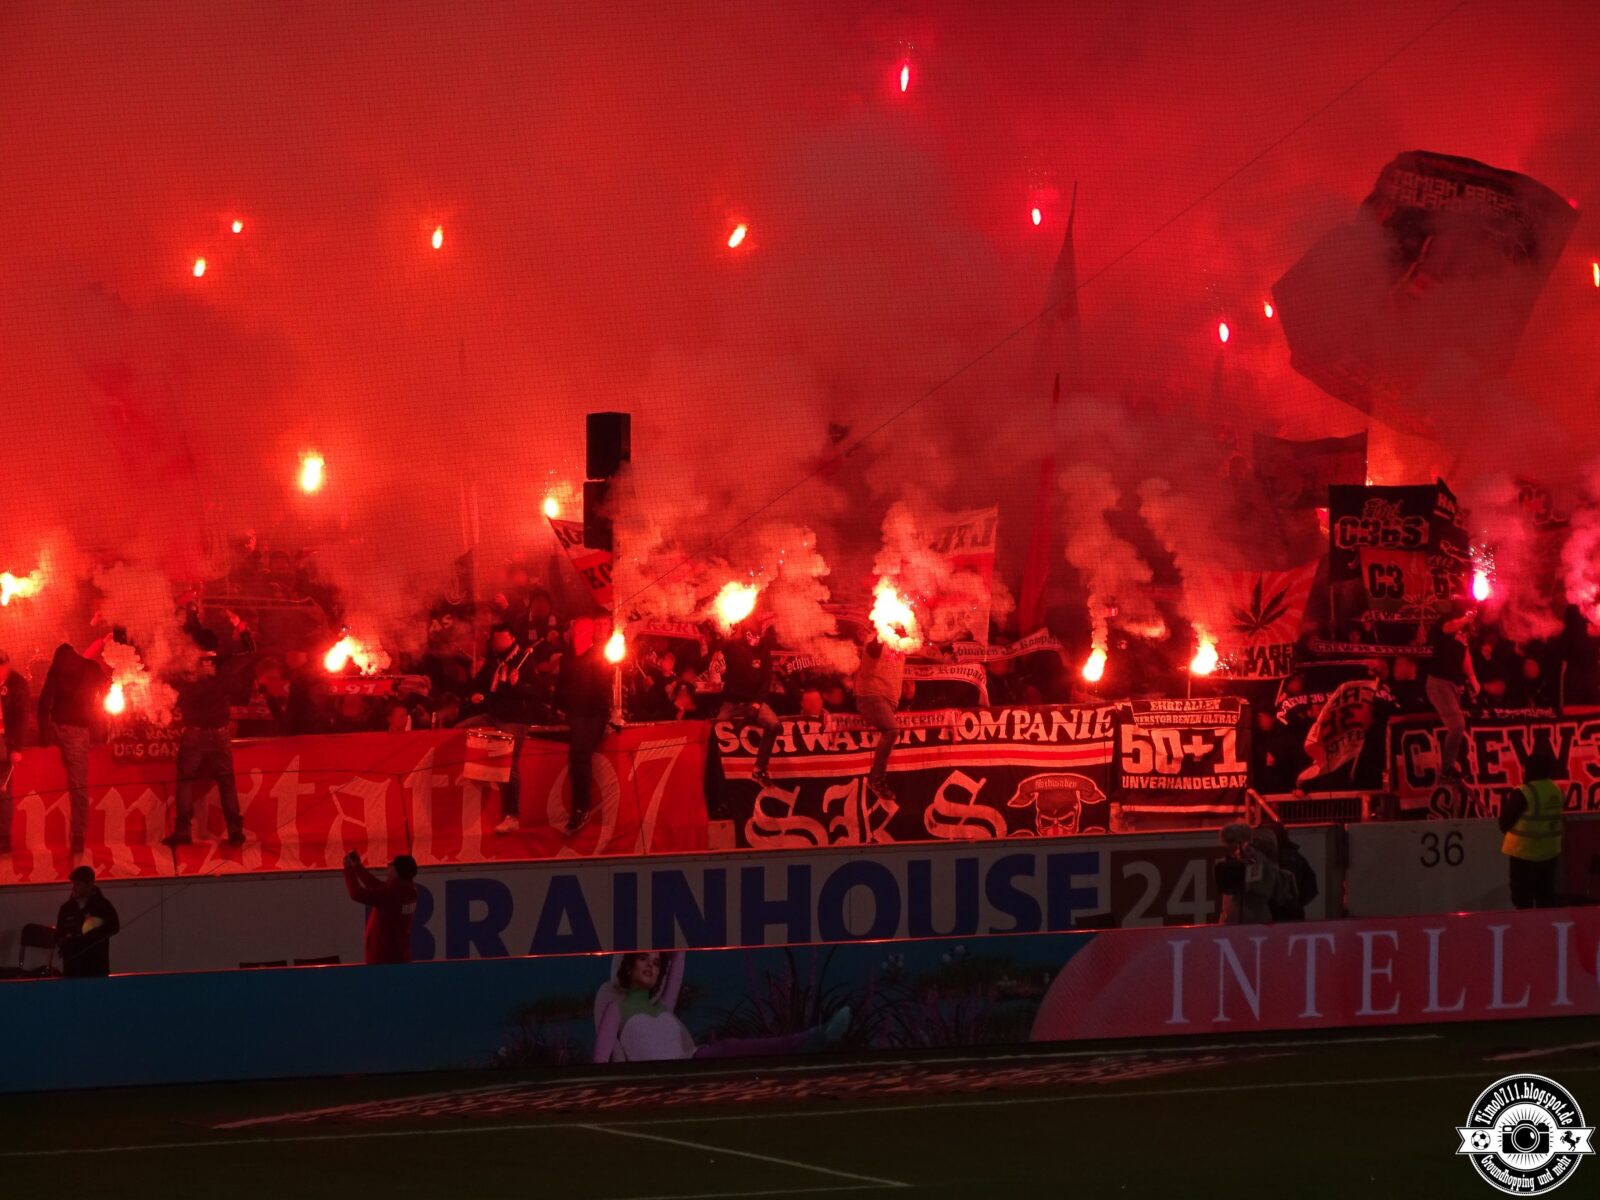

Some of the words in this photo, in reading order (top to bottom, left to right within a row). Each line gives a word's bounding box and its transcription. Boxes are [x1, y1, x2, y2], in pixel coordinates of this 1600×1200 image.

[1150, 700, 1184, 712] EHRE
[1184, 699, 1221, 711] ALLEN
[1203, 712, 1239, 725] ULTRAS
[1121, 723, 1248, 775] 50+1
[1121, 773, 1248, 791] UNVERHANDELBAR
[1420, 831, 1464, 867] 36
[1166, 920, 1600, 1024] INTELLI
